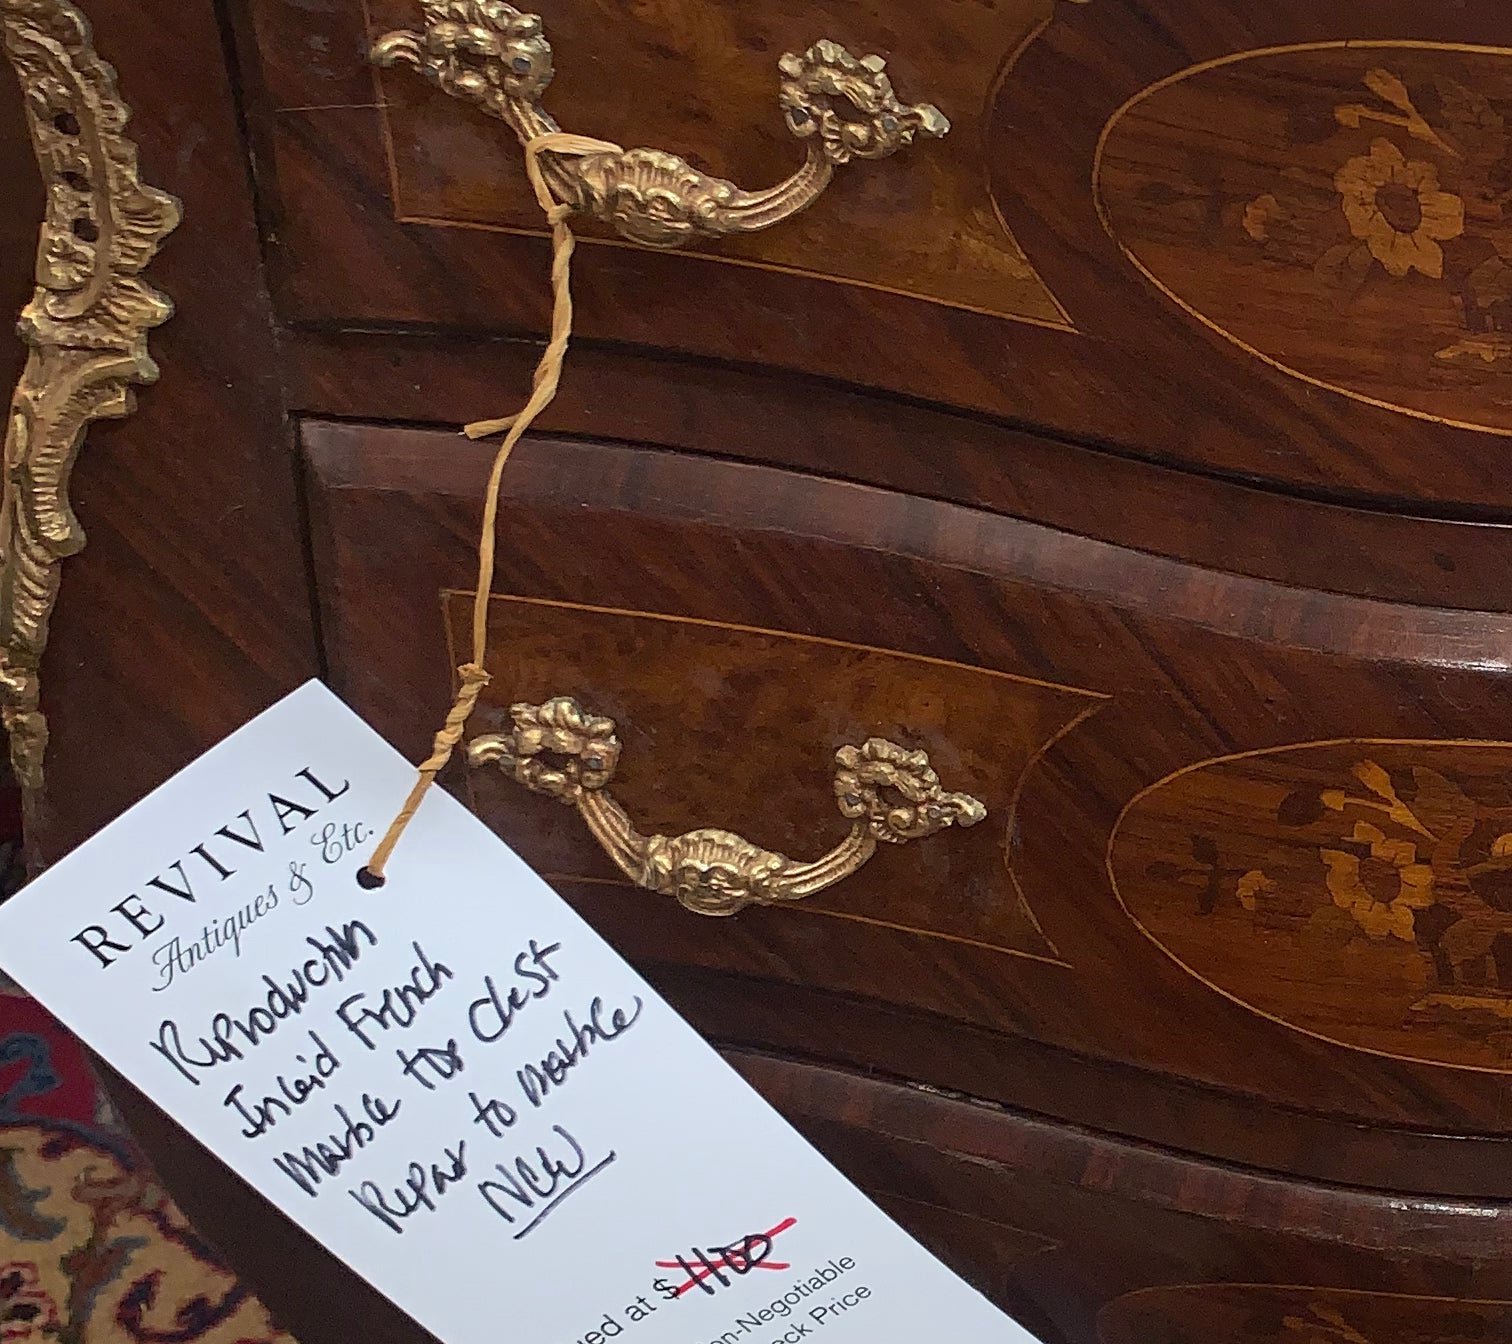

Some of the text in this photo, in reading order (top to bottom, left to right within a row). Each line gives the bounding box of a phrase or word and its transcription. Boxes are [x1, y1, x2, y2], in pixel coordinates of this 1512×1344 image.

[69, 766, 350, 969] REVIVAL
[151, 821, 375, 992] Antiques & Etc.
[335, 941, 454, 1051] French
[467, 1092, 517, 1139] to
[624, 1295, 658, 1323] at
[808, 1283, 873, 1326] Price
